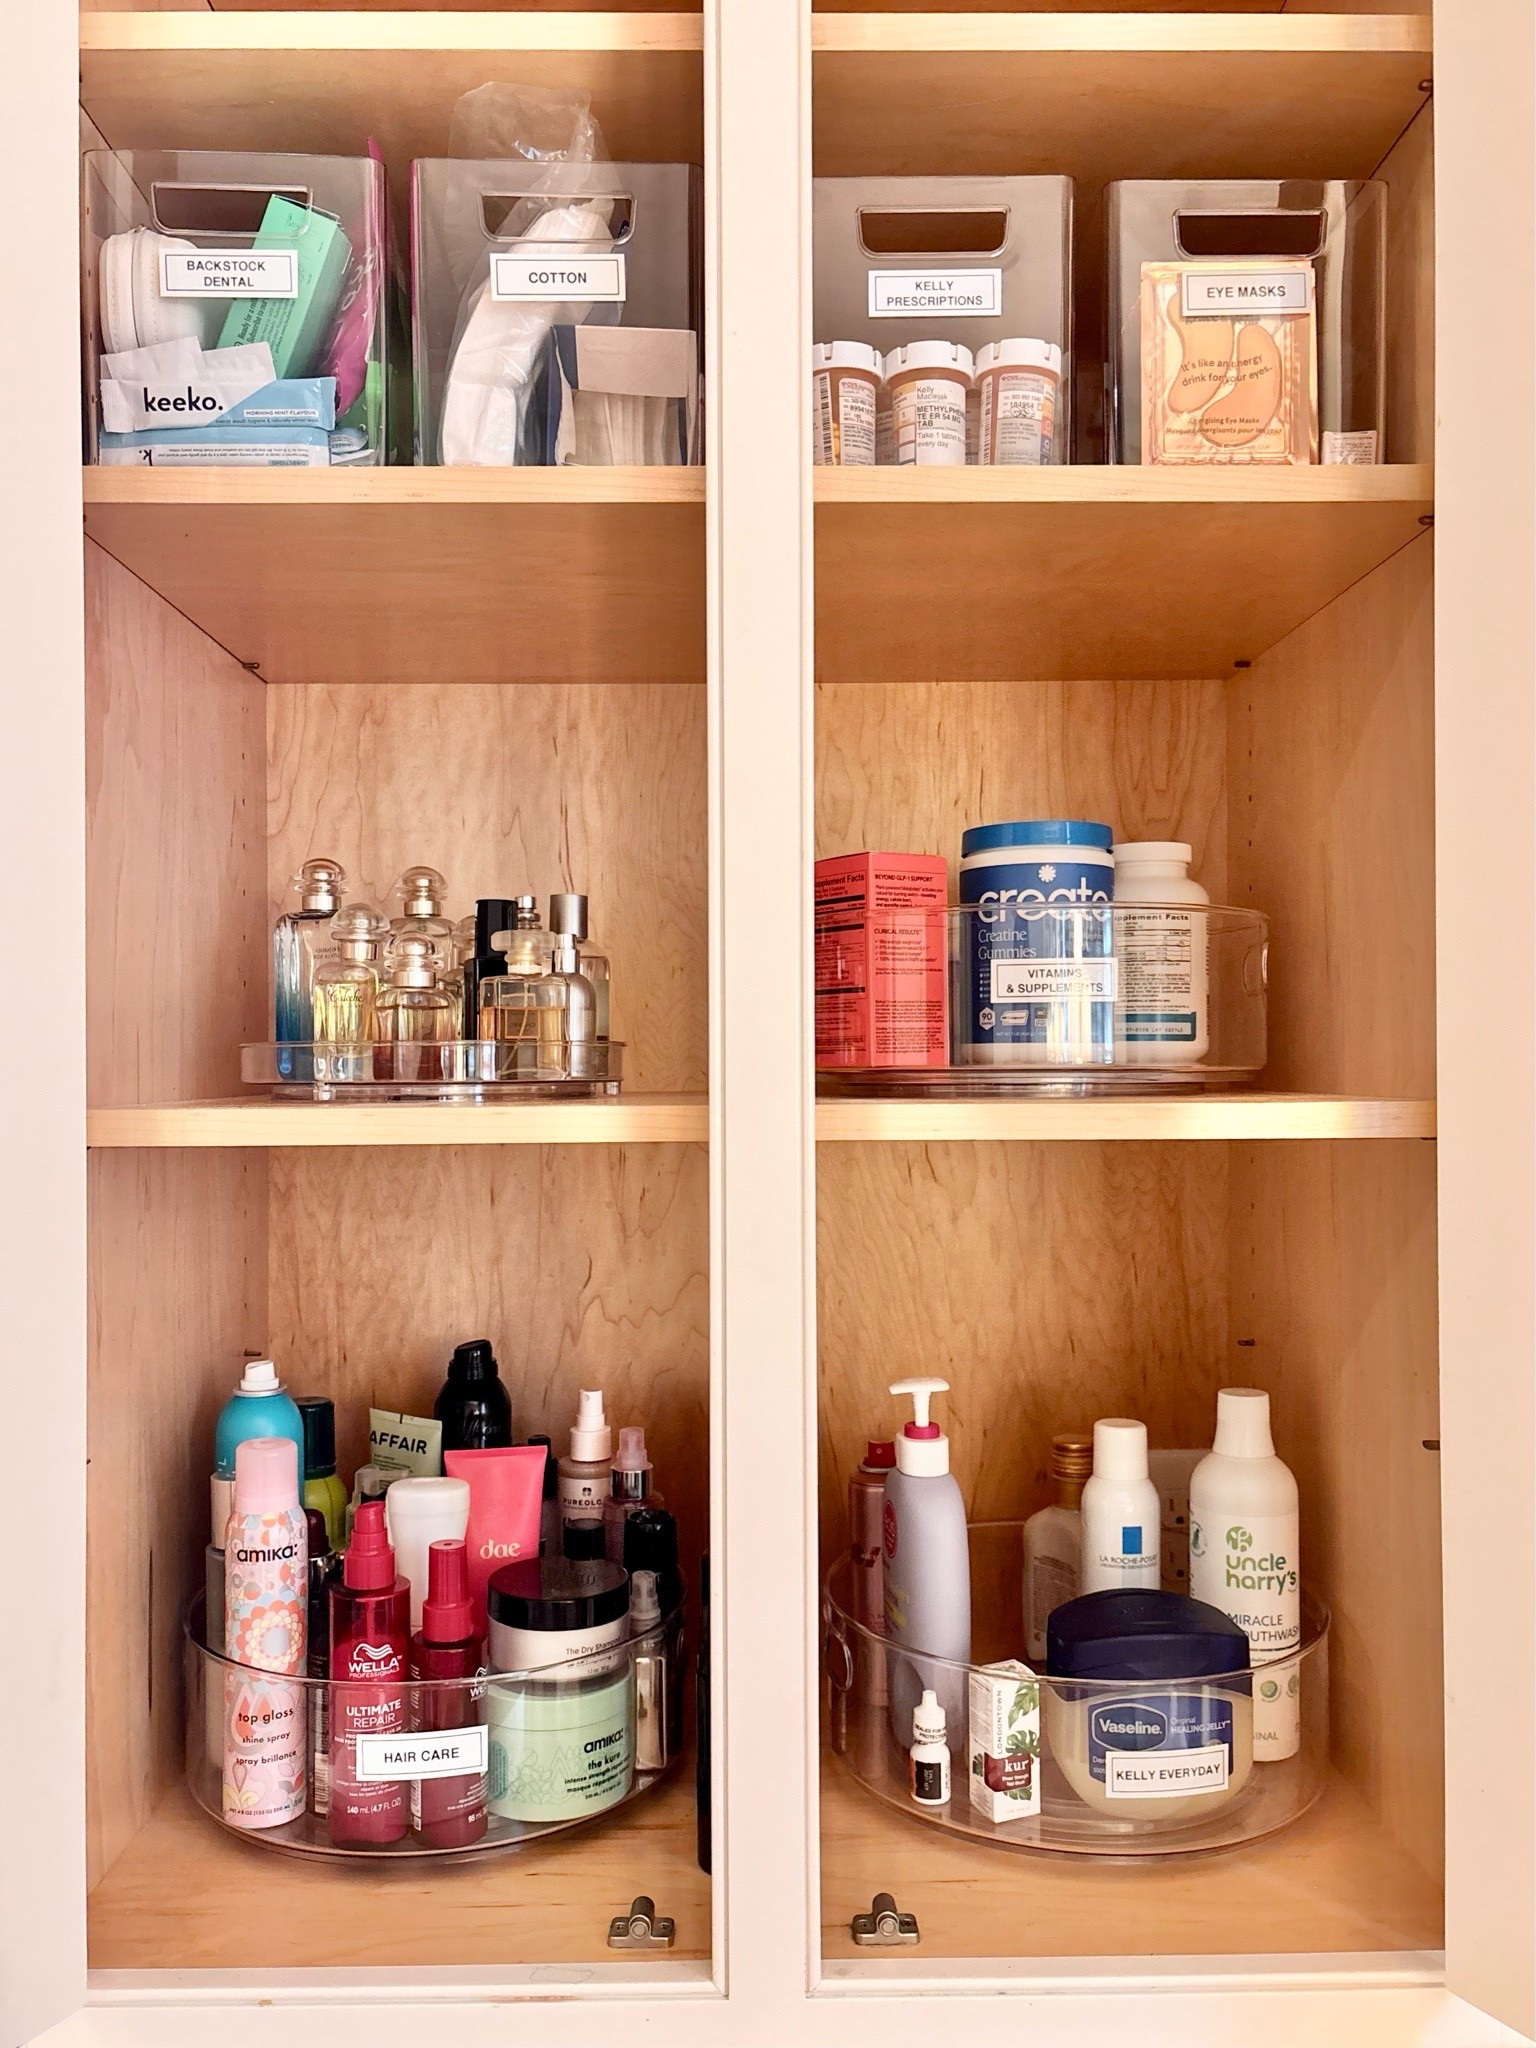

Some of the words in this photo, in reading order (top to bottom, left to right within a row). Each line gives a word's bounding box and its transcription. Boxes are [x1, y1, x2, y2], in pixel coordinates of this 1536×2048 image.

[186, 260, 267, 272] BACKSTOCK
[203, 276, 255, 288] DENTAL
[528, 271, 588, 284] COTTON
[914, 280, 954, 291] KELLY
[1206, 286, 1234, 299] EYE
[1237, 285, 1287, 298] MASKS
[886, 295, 984, 307] PRESCRIPTIONS
[237, 321, 251, 341] Ready
[246, 316, 262, 343] Subscribe
[1180, 361, 1197, 373] It's
[1197, 358, 1215, 368] like
[1216, 360, 1228, 368] an
[1231, 354, 1263, 368] energy
[1181, 373, 1207, 387] drink
[1208, 372, 1224, 382] for
[1223, 374, 1247, 387] your
[1248, 365, 1273, 382] eyes.
[917, 386, 935, 394] Kelly
[143, 386, 224, 413] keeko.
[1225, 417, 1239, 425] Eye
[1237, 428, 1255, 436] pour
[936, 440, 949, 448] day
[814, 875, 846, 888] upplement
[846, 873, 865, 883] Facts
[874, 873, 896, 881] BEYOND
[977, 929, 1028, 943] Creatine
[977, 945, 1037, 960] Gummies
[1027, 968, 1083, 979] VITAMINS
[1006, 984, 1014, 993] &
[981, 1012, 993, 1021] 90
[369, 1430, 428, 1455] AFFAIR
[479, 1538, 521, 1560] dae
[1099, 1554, 1109, 1562] LA
[1225, 1552, 1287, 1572] uncle
[1225, 1569, 1297, 1596] harry's
[1227, 1612, 1283, 1627] MIRACLE
[565, 1647, 580, 1656] The
[581, 1646, 594, 1654] Dry
[348, 1657, 400, 1673] WELLA
[345, 1698, 402, 1717] ULTIMATE
[238, 1711, 259, 1726] top
[262, 1707, 294, 1725] gloss
[353, 1712, 396, 1728] REPAIR
[1170, 1716, 1196, 1726] Original
[1170, 1724, 1205, 1735] HEALING
[1253, 1731, 1279, 1741] INAL
[242, 1735, 264, 1744] shine
[266, 1731, 291, 1743] spray
[235, 1756, 259, 1767] spray
[261, 1750, 297, 1764] brillance
[383, 1751, 416, 1764] HAIR
[421, 1746, 460, 1762] CARE
[1092, 1755, 1107, 1764] Der
[587, 1759, 603, 1771] the
[1116, 1769, 1157, 1781] KELLY
[1159, 1763, 1221, 1780] EVERYDAY
[564, 1775, 588, 1785] intense
[566, 1784, 592, 1793] masque
[346, 1805, 359, 1814] 140
[359, 1805, 370, 1814] mL
